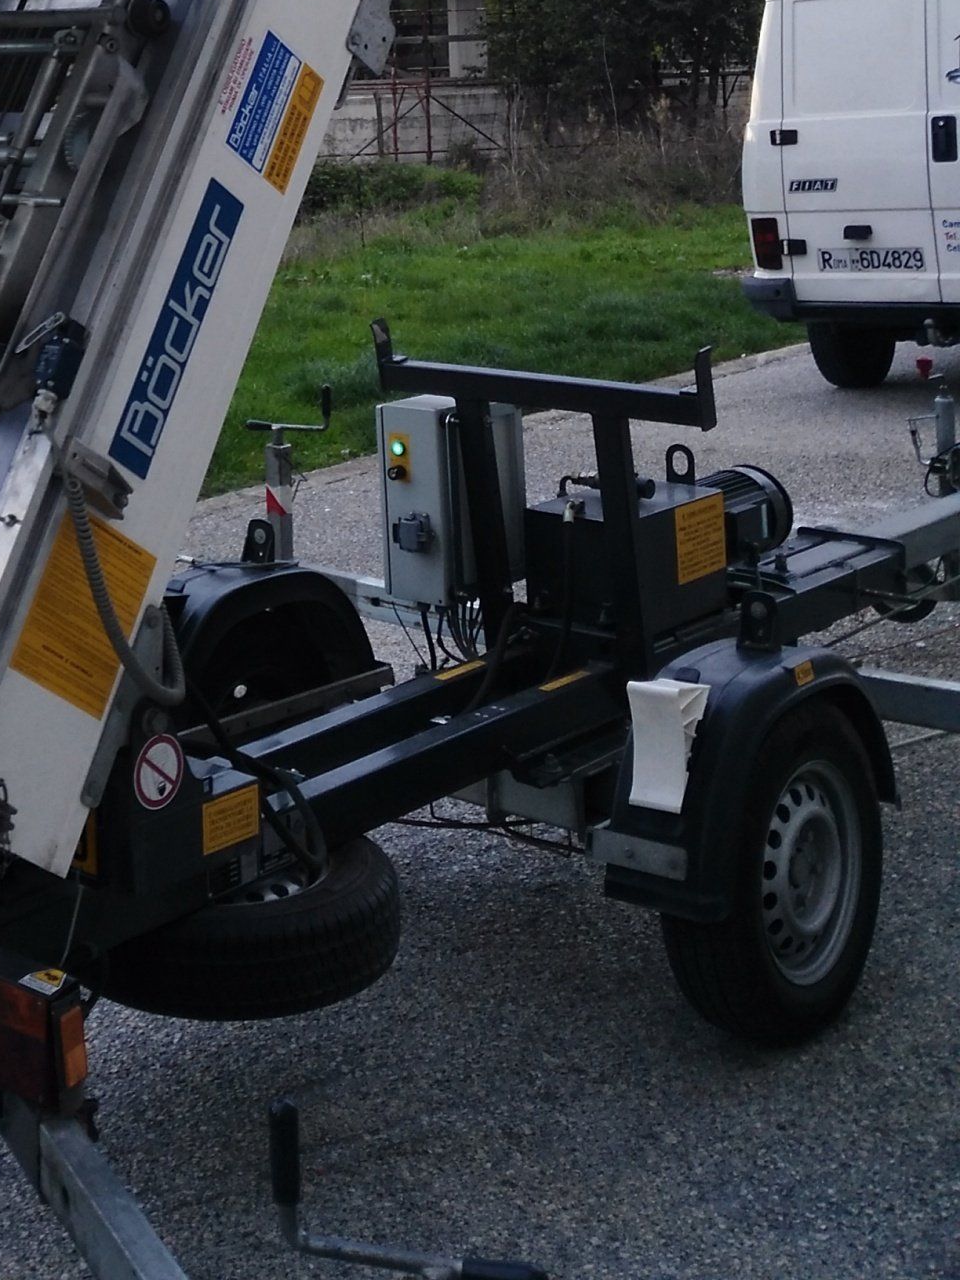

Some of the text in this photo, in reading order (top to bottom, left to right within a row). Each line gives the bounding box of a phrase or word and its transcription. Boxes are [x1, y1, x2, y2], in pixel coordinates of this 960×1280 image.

[790, 179, 836, 191] FIAT
[860, 250, 924, 269] 6D4829
[119, 204, 230, 457] Böcker
